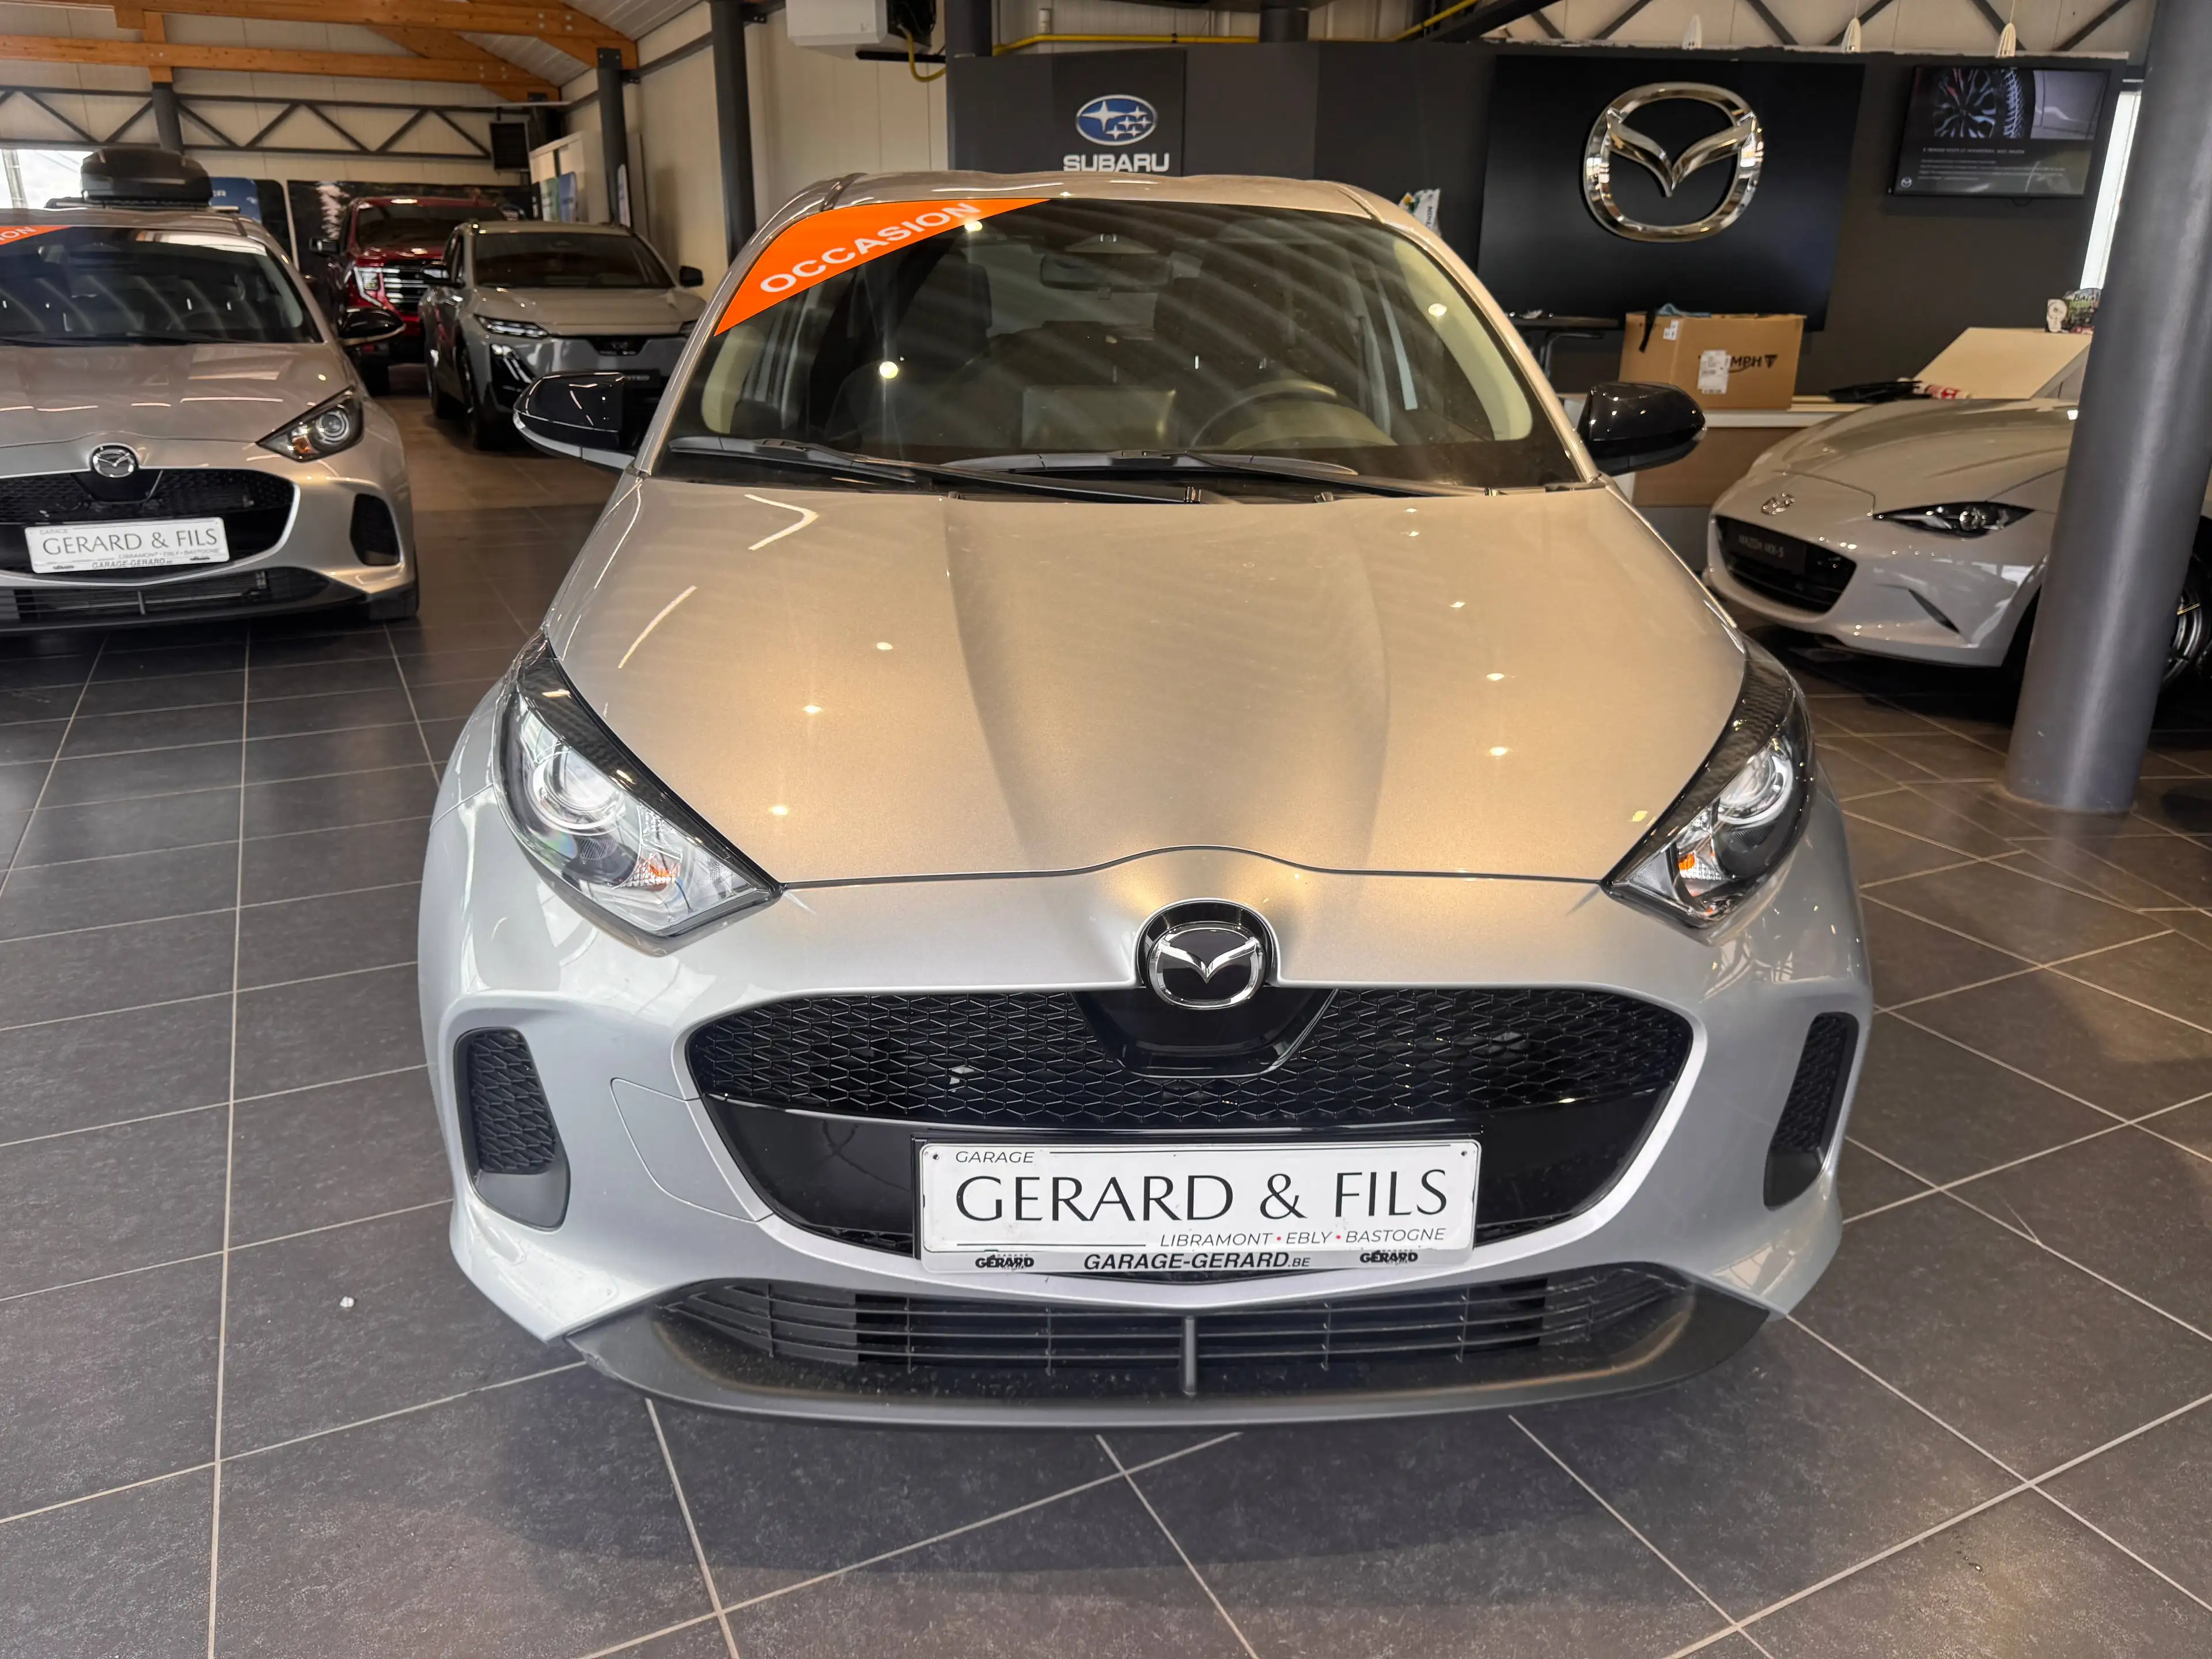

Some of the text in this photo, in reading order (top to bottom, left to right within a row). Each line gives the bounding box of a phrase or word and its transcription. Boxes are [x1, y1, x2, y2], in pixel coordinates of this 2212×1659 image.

[1063, 152, 1170, 172] SUBARU
[760, 202, 982, 293] OCCASION
[43, 528, 218, 555] GERARD & FILS
[956, 1151, 1035, 1164] GARAGE
[956, 1169, 1447, 1222] GERARD & FILS
[1160, 1228, 1446, 1247] LIBRAMONT EBLY BASTOGNE
